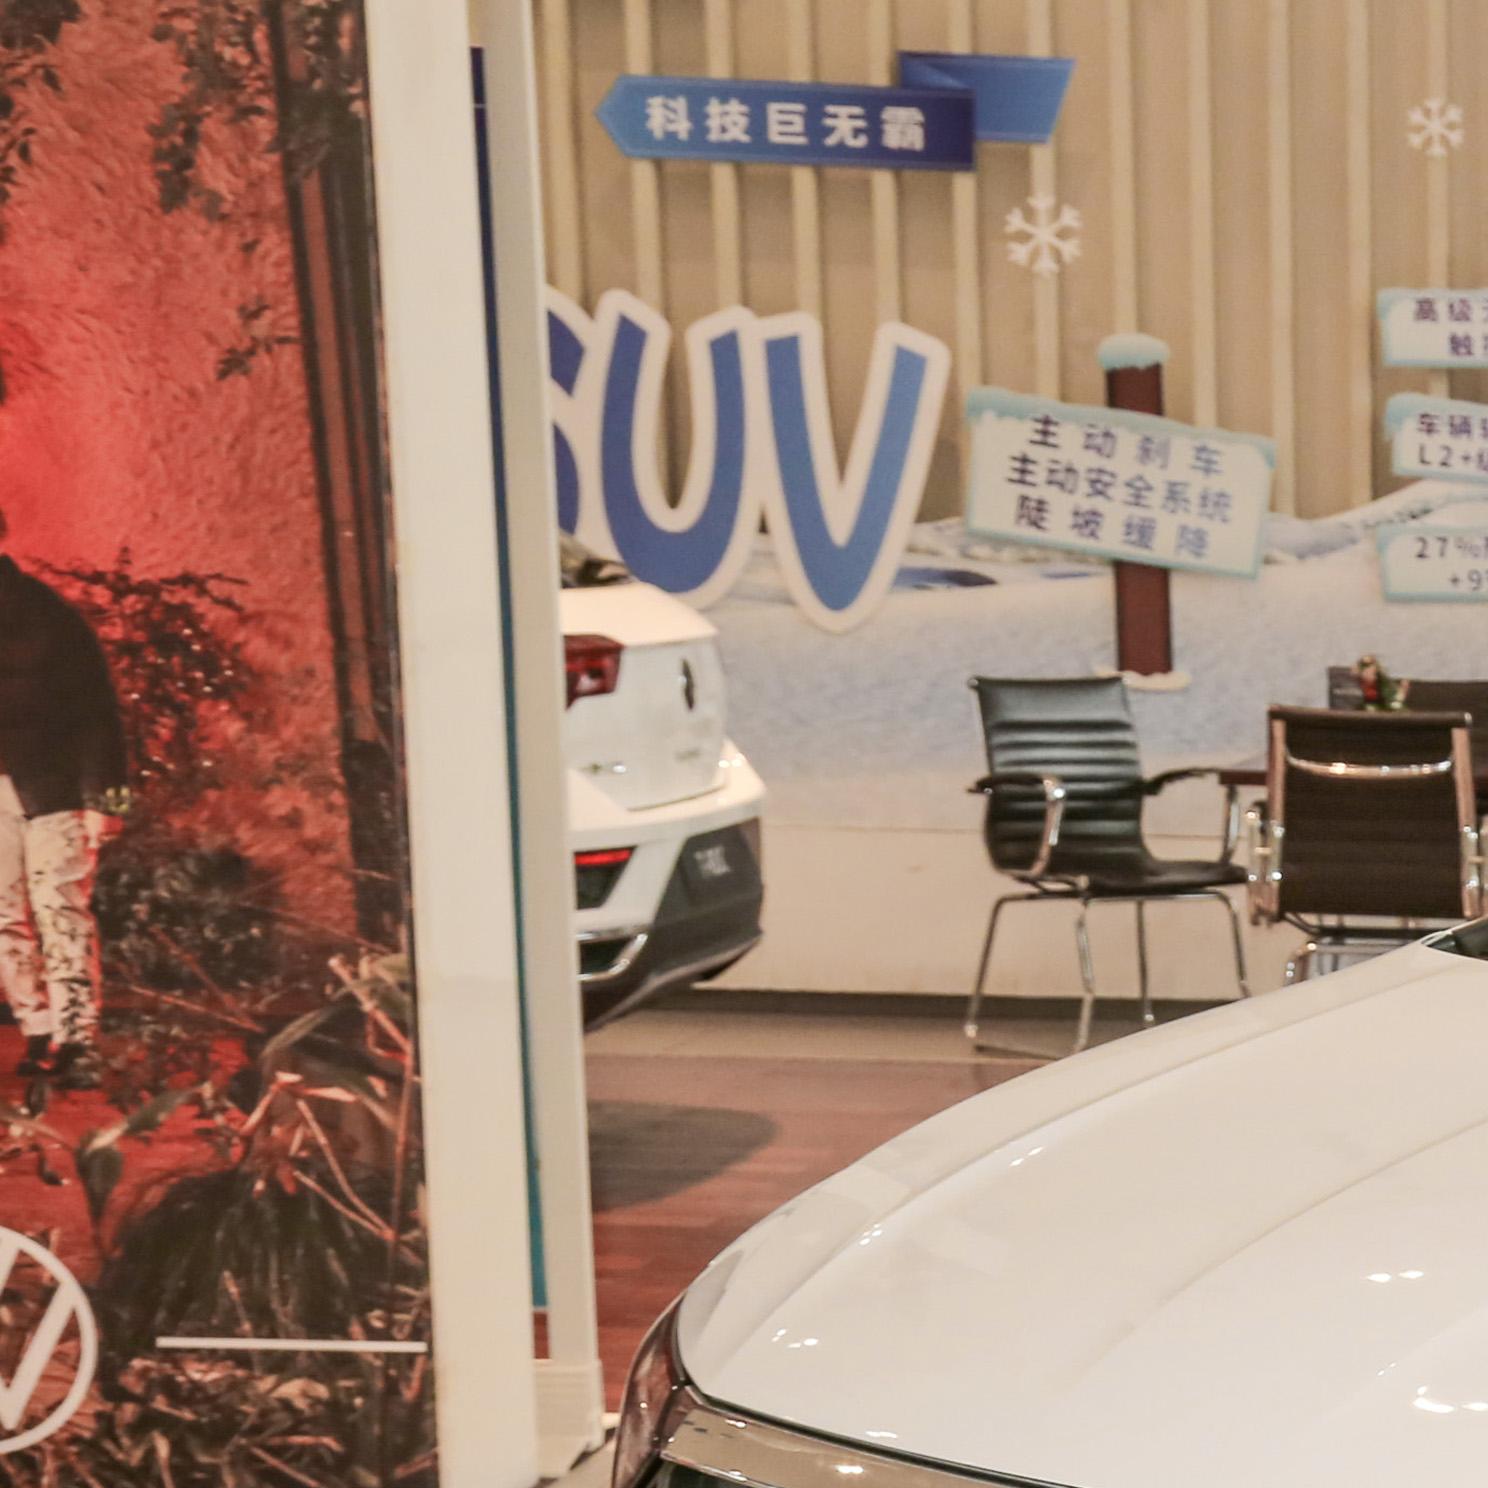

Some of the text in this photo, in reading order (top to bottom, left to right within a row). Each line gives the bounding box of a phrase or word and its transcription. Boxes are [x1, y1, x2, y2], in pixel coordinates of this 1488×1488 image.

[645, 95, 925, 151] 科技巨无霸
[1029, 414, 1224, 477] 主动刹车
[1006, 452, 1232, 524] 主动安全系统
[1015, 494, 1210, 558] 陡坡缓降
